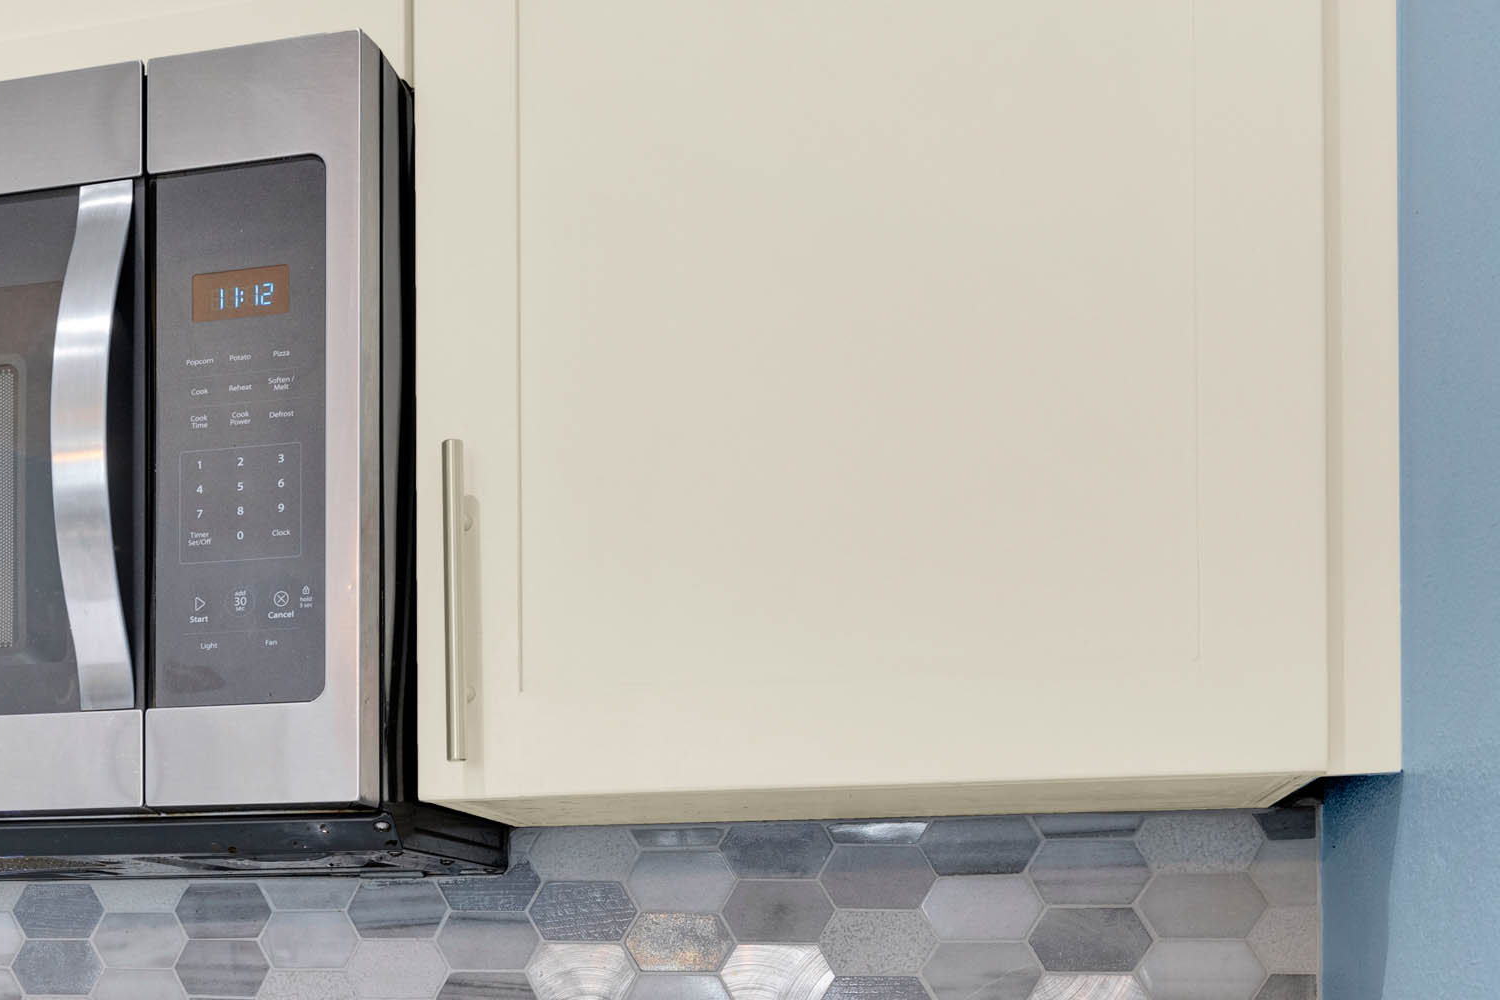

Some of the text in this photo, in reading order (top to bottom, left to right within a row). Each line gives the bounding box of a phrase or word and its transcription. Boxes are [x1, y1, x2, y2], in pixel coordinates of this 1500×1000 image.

[219, 282, 275, 311] 11:12
[229, 354, 252, 362] Potato
[272, 350, 291, 358] Pizza
[186, 358, 214, 367] Popcorn
[190, 388, 209, 396] Cook
[228, 384, 253, 392] Reheat
[190, 414, 208, 422] Cook
[231, 411, 250, 419] Cook
[268, 410, 295, 419] Defrost
[229, 418, 251, 426] Power
[236, 456, 244, 467] 2
[277, 453, 285, 463] 3
[197, 460, 203, 470] 1
[236, 481, 244, 491] 5
[277, 478, 285, 488] 6
[196, 484, 204, 494] 4
[236, 505, 245, 516] 8
[277, 503, 285, 513] 9
[196, 509, 204, 519] 7
[189, 531, 209, 539] Timer
[236, 530, 244, 540] 0
[271, 528, 291, 537] Clock
[234, 597, 247, 606] 30
[267, 610, 295, 619] Cancel
[189, 615, 209, 624] Start
[200, 642, 218, 651] Light
